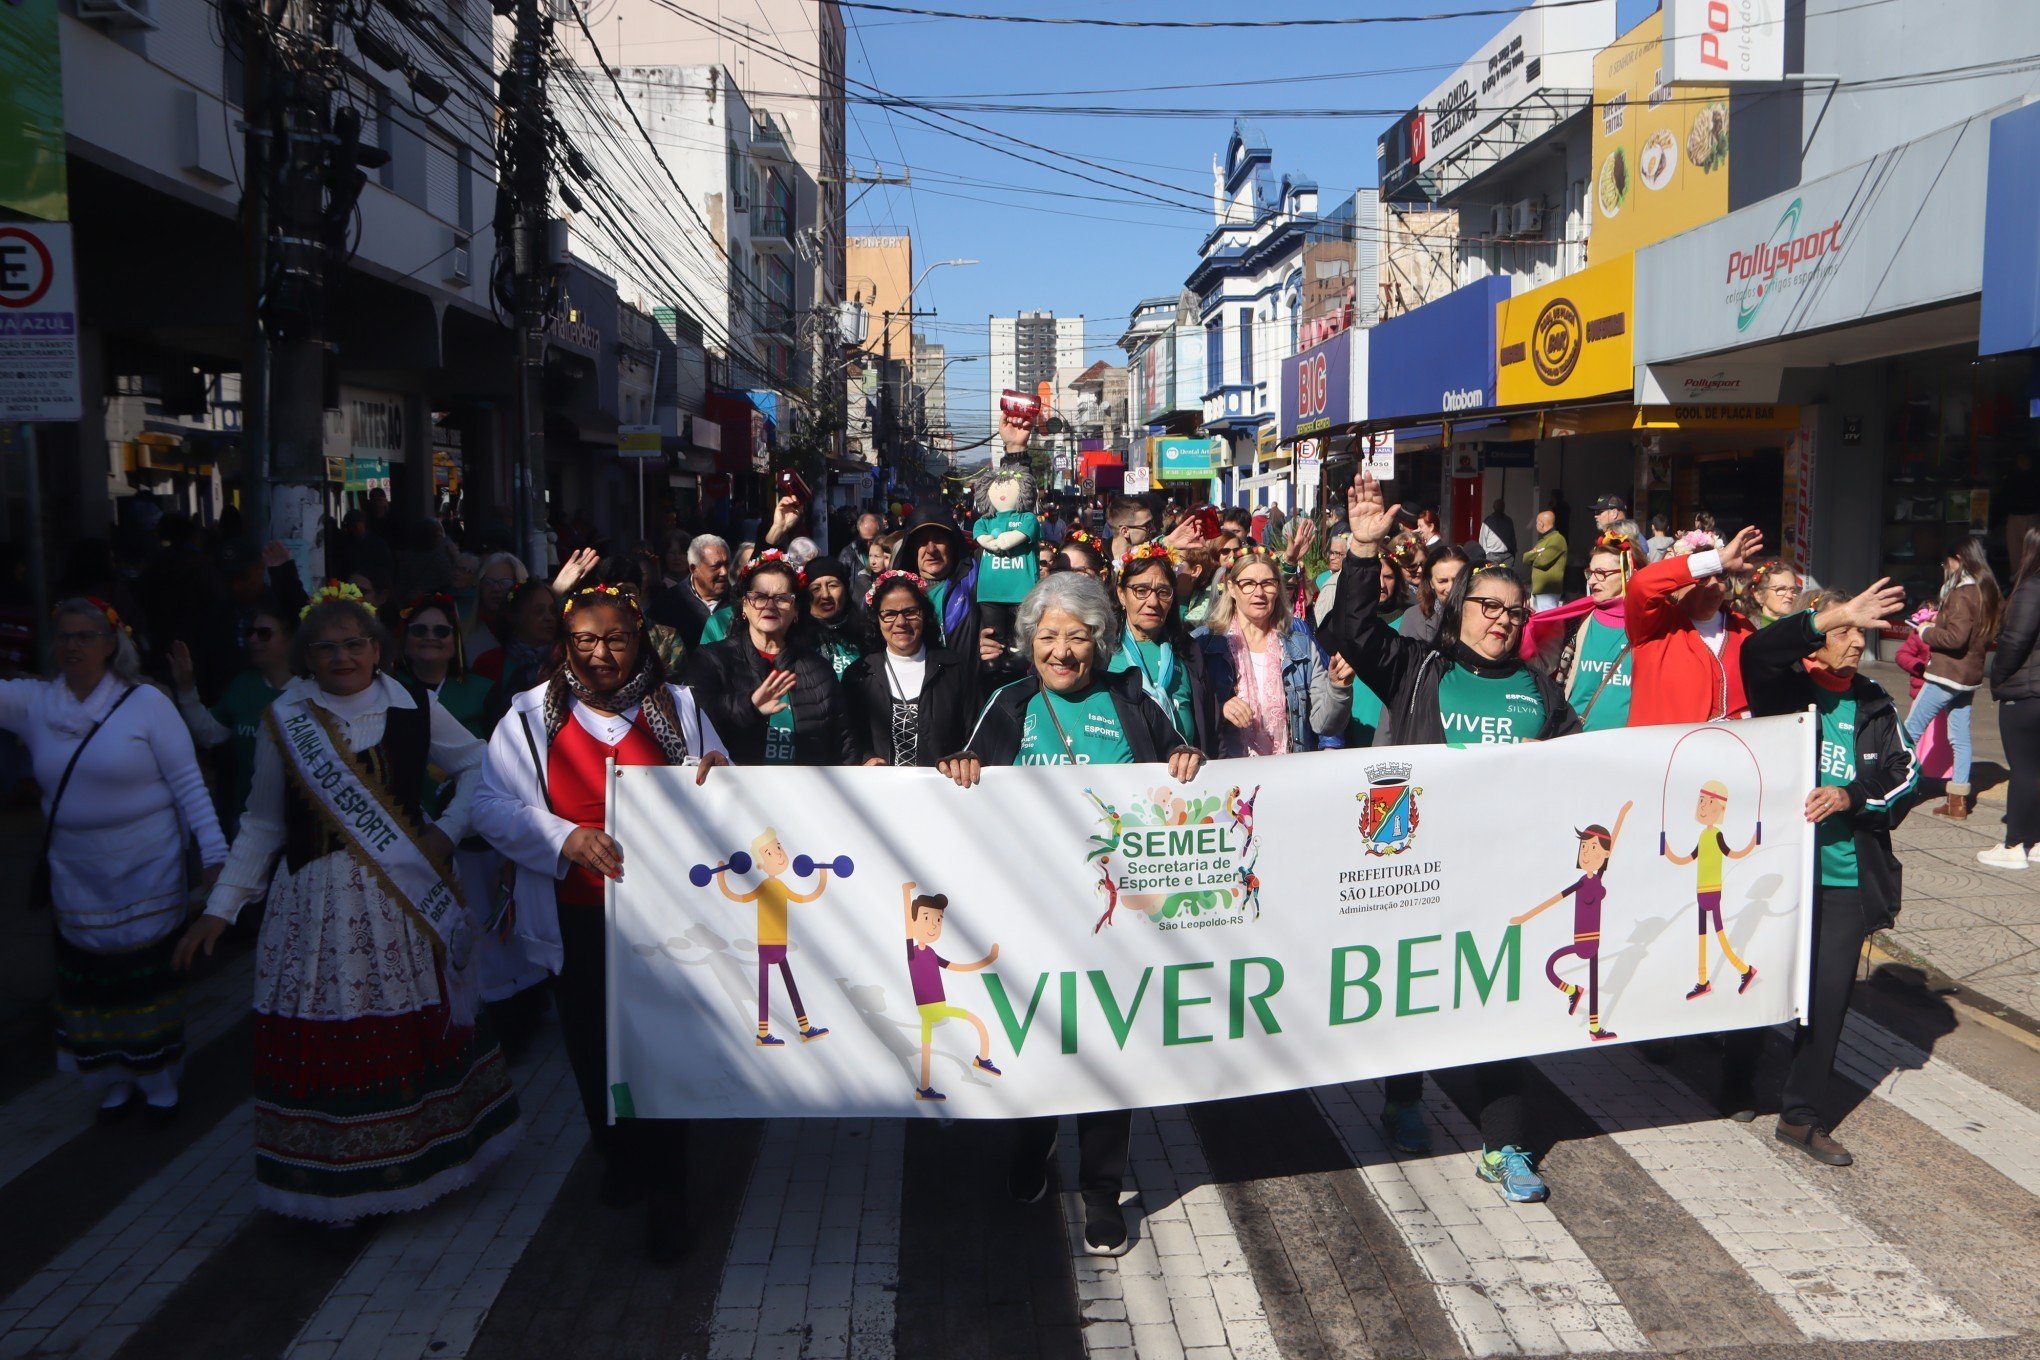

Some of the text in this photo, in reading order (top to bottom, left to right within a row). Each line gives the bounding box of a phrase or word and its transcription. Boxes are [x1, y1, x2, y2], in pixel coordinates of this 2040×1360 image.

[1738, 0, 1752, 73] calçado
[1613, 51, 1634, 76] SENHOR
[1605, 112, 1624, 137] FRITAS
[1726, 219, 1843, 285] Pollysport
[1726, 285, 1756, 305] calçados
[1764, 277, 1791, 294] artigos
[22, 318, 71, 330] AZUL
[1299, 352, 1327, 418] BIG
[1684, 378, 1742, 389] Pollysport
[1443, 388, 1483, 412] Ortobom
[1675, 406, 1702, 419] GOOL
[1705, 407, 1718, 419] DE
[1755, 406, 1775, 419] BAR
[1303, 444, 1310, 455] E
[992, 556, 1024, 570] BEM
[1505, 694, 1538, 706] ESPORTE
[1506, 705, 1538, 716] SILVIA
[237, 726, 258, 738] VIV
[1084, 725, 1120, 738] ESPORTE
[1440, 712, 1512, 736] VIVER
[1820, 756, 1856, 782] BEM
[284, 713, 399, 853] RAINHA DO ESPORTE
[1122, 828, 1237, 859] SEMEL
[1127, 856, 1231, 876] Secretaria de
[1338, 860, 1442, 885] PREFEITURA DE
[1119, 870, 1239, 893] Esporte e Lazer
[1339, 878, 1441, 903] SÃO LEOPOLDO
[417, 880, 448, 915] VIVER
[431, 895, 453, 923] BEM
[1338, 895, 1442, 916] Administração 2017/2020
[1158, 915, 1244, 932] São Leopoldo-RS
[980, 923, 1522, 1058] VIVER BEM
